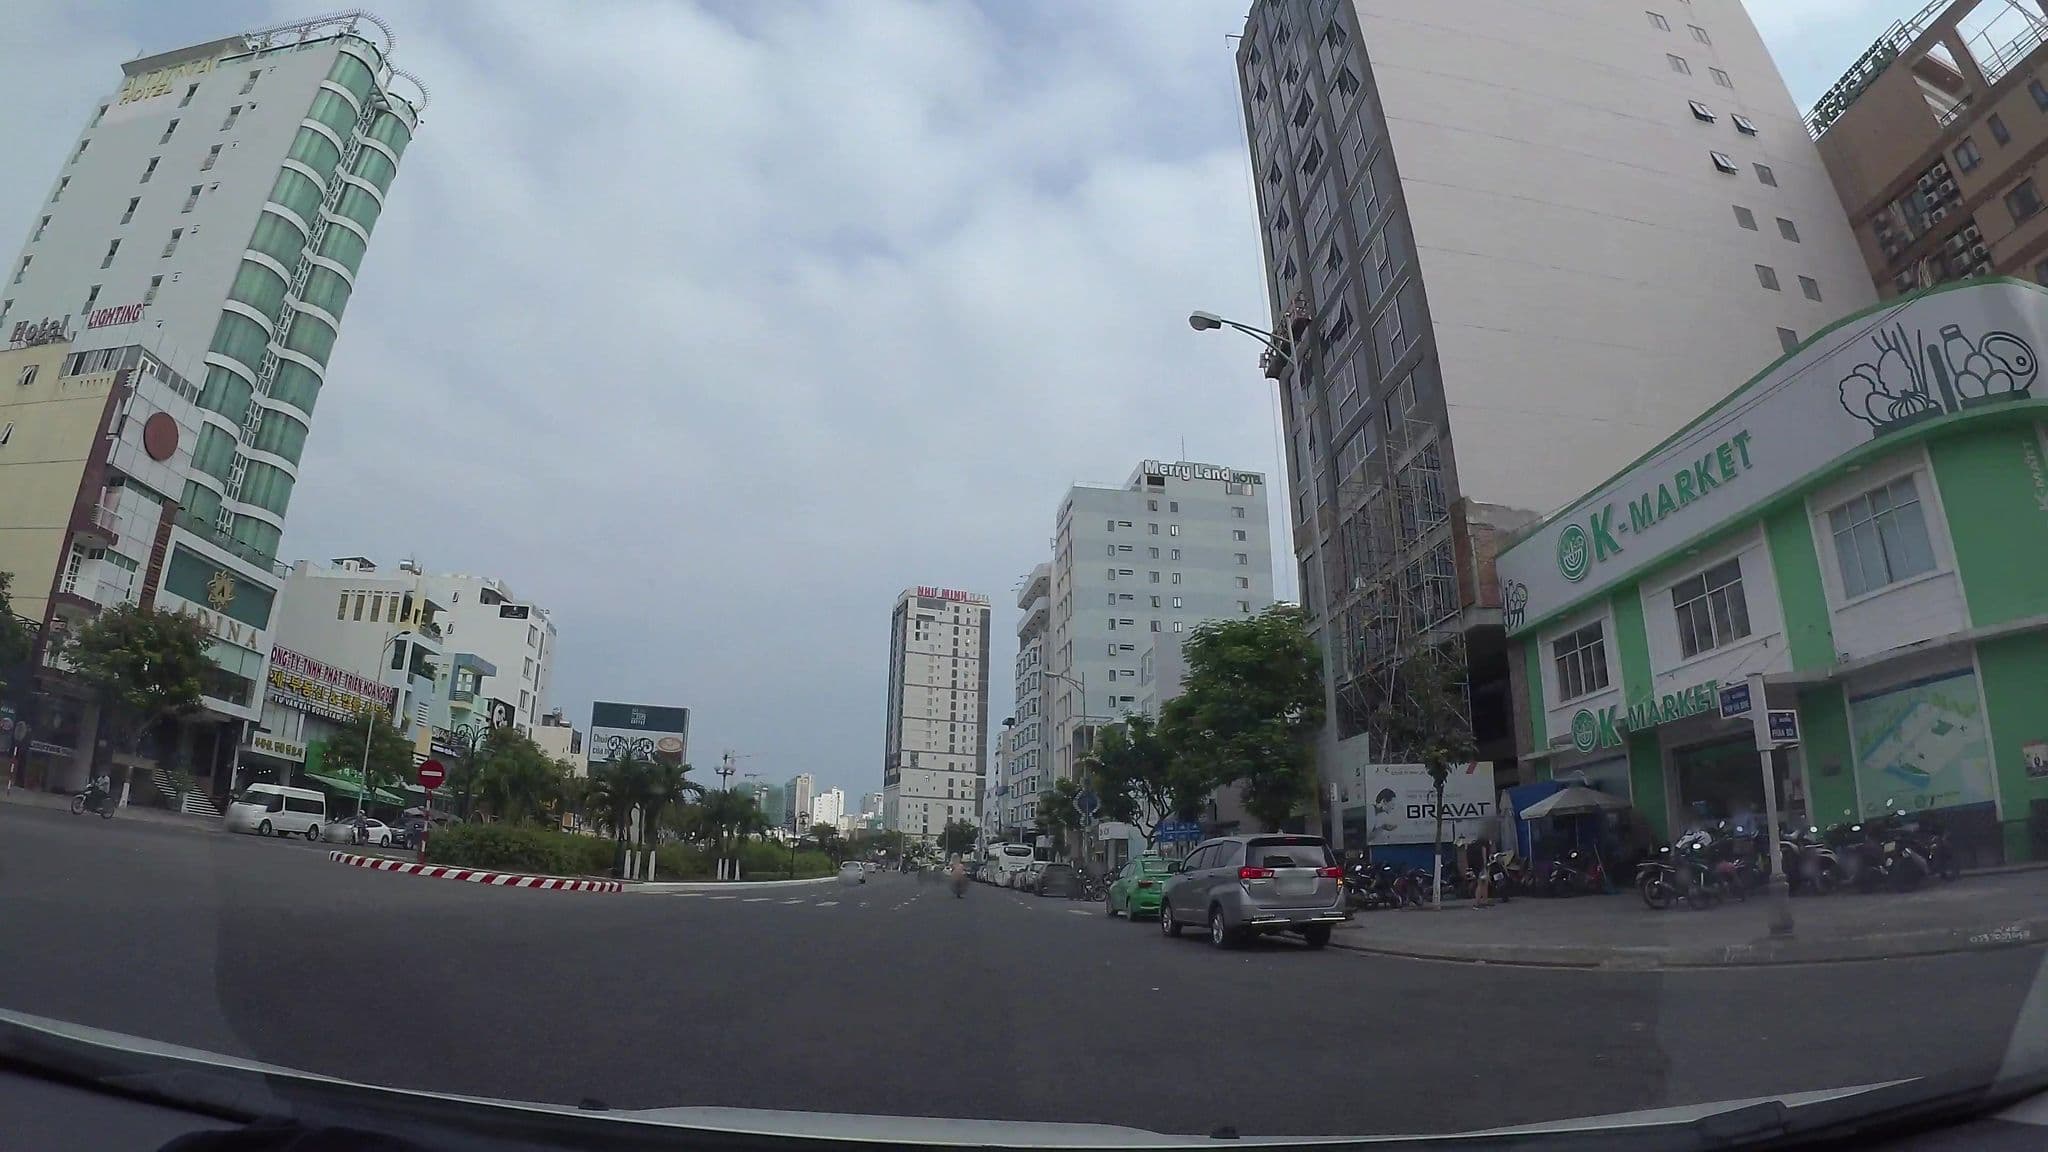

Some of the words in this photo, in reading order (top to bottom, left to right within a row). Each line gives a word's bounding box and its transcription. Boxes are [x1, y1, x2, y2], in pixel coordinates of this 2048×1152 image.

[9, 314, 71, 343] Hotel
[88, 303, 143, 329] LIGHTING
[1144, 459, 1191, 482] Merry
[1194, 467, 1231, 482] Land
[1232, 473, 1262, 485] HOTEL
[942, 589, 967, 602] MINH
[1407, 802, 1490, 819] BRAVAT
